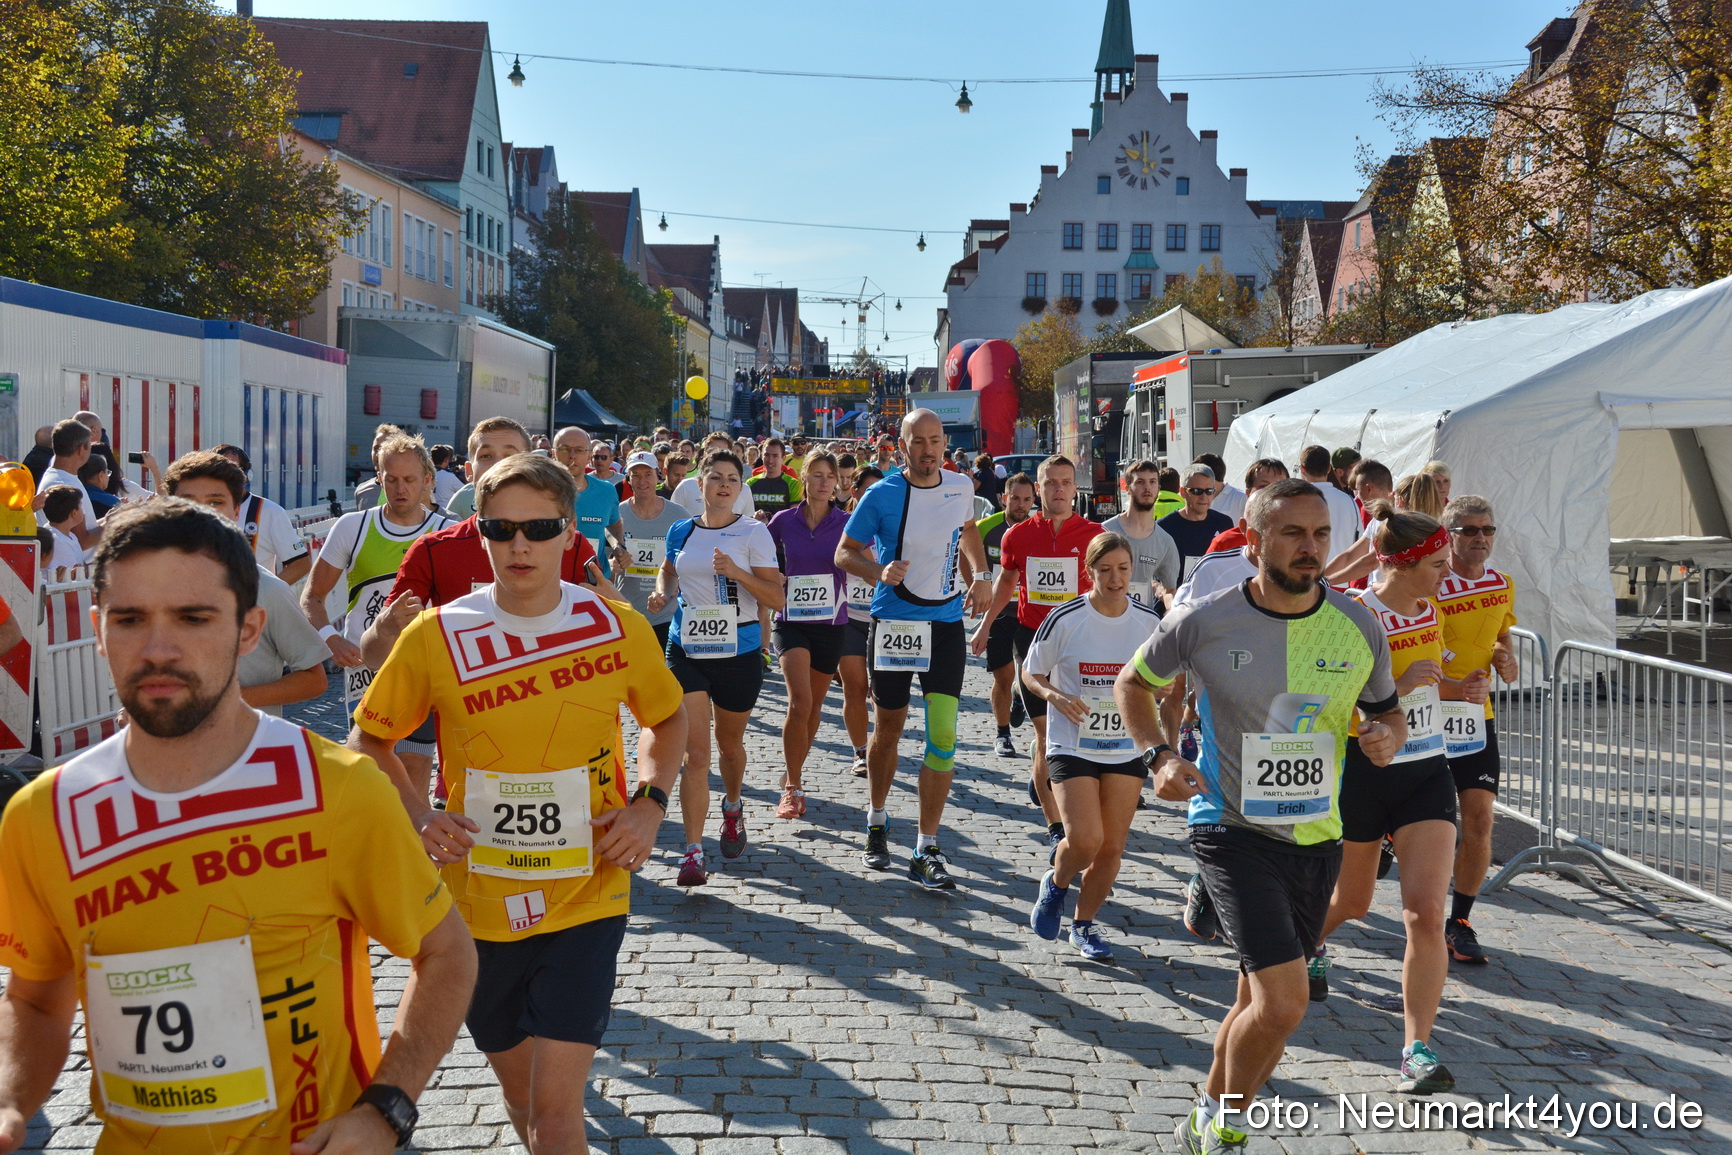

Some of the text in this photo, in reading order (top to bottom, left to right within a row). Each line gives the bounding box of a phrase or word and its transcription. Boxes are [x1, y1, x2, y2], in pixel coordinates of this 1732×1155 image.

[803, 382, 837, 390] START
[753, 494, 785, 502] BOCK
[638, 550, 654, 562] 24
[1037, 571, 1066, 586] 204
[793, 587, 827, 602] 2572
[1040, 593, 1064, 601] Michael
[800, 608, 822, 616] Kathrin
[1442, 601, 1477, 617] MAX
[688, 619, 728, 636] 2492
[891, 624, 916, 632] BOCK
[693, 642, 724, 653] Christina
[883, 634, 922, 650] 2494
[1389, 636, 1418, 651] MAX
[890, 658, 916, 667] Michael
[1082, 664, 1123, 674] AUTOMO
[463, 651, 628, 715] MAX BÖGL
[1089, 712, 1125, 731] 219
[1096, 740, 1120, 749] Nadine
[1271, 741, 1314, 752] BOCK
[1404, 742, 1431, 753] Marina
[1446, 743, 1469, 753] erbert
[1256, 757, 1324, 787] 2888
[499, 781, 554, 795] BOCK
[1285, 789, 1313, 797] Neumarkt
[1277, 802, 1306, 815] Erich
[493, 802, 562, 836] 258
[492, 837, 517, 847] PARTL
[506, 853, 551, 868] Julian
[74, 831, 328, 928] MAX BÖGL
[107, 963, 194, 990] BOCK
[121, 1001, 195, 1055] 79
[118, 1060, 208, 1074] PARTL Neumarkt
[133, 1084, 218, 1109] Mathias
